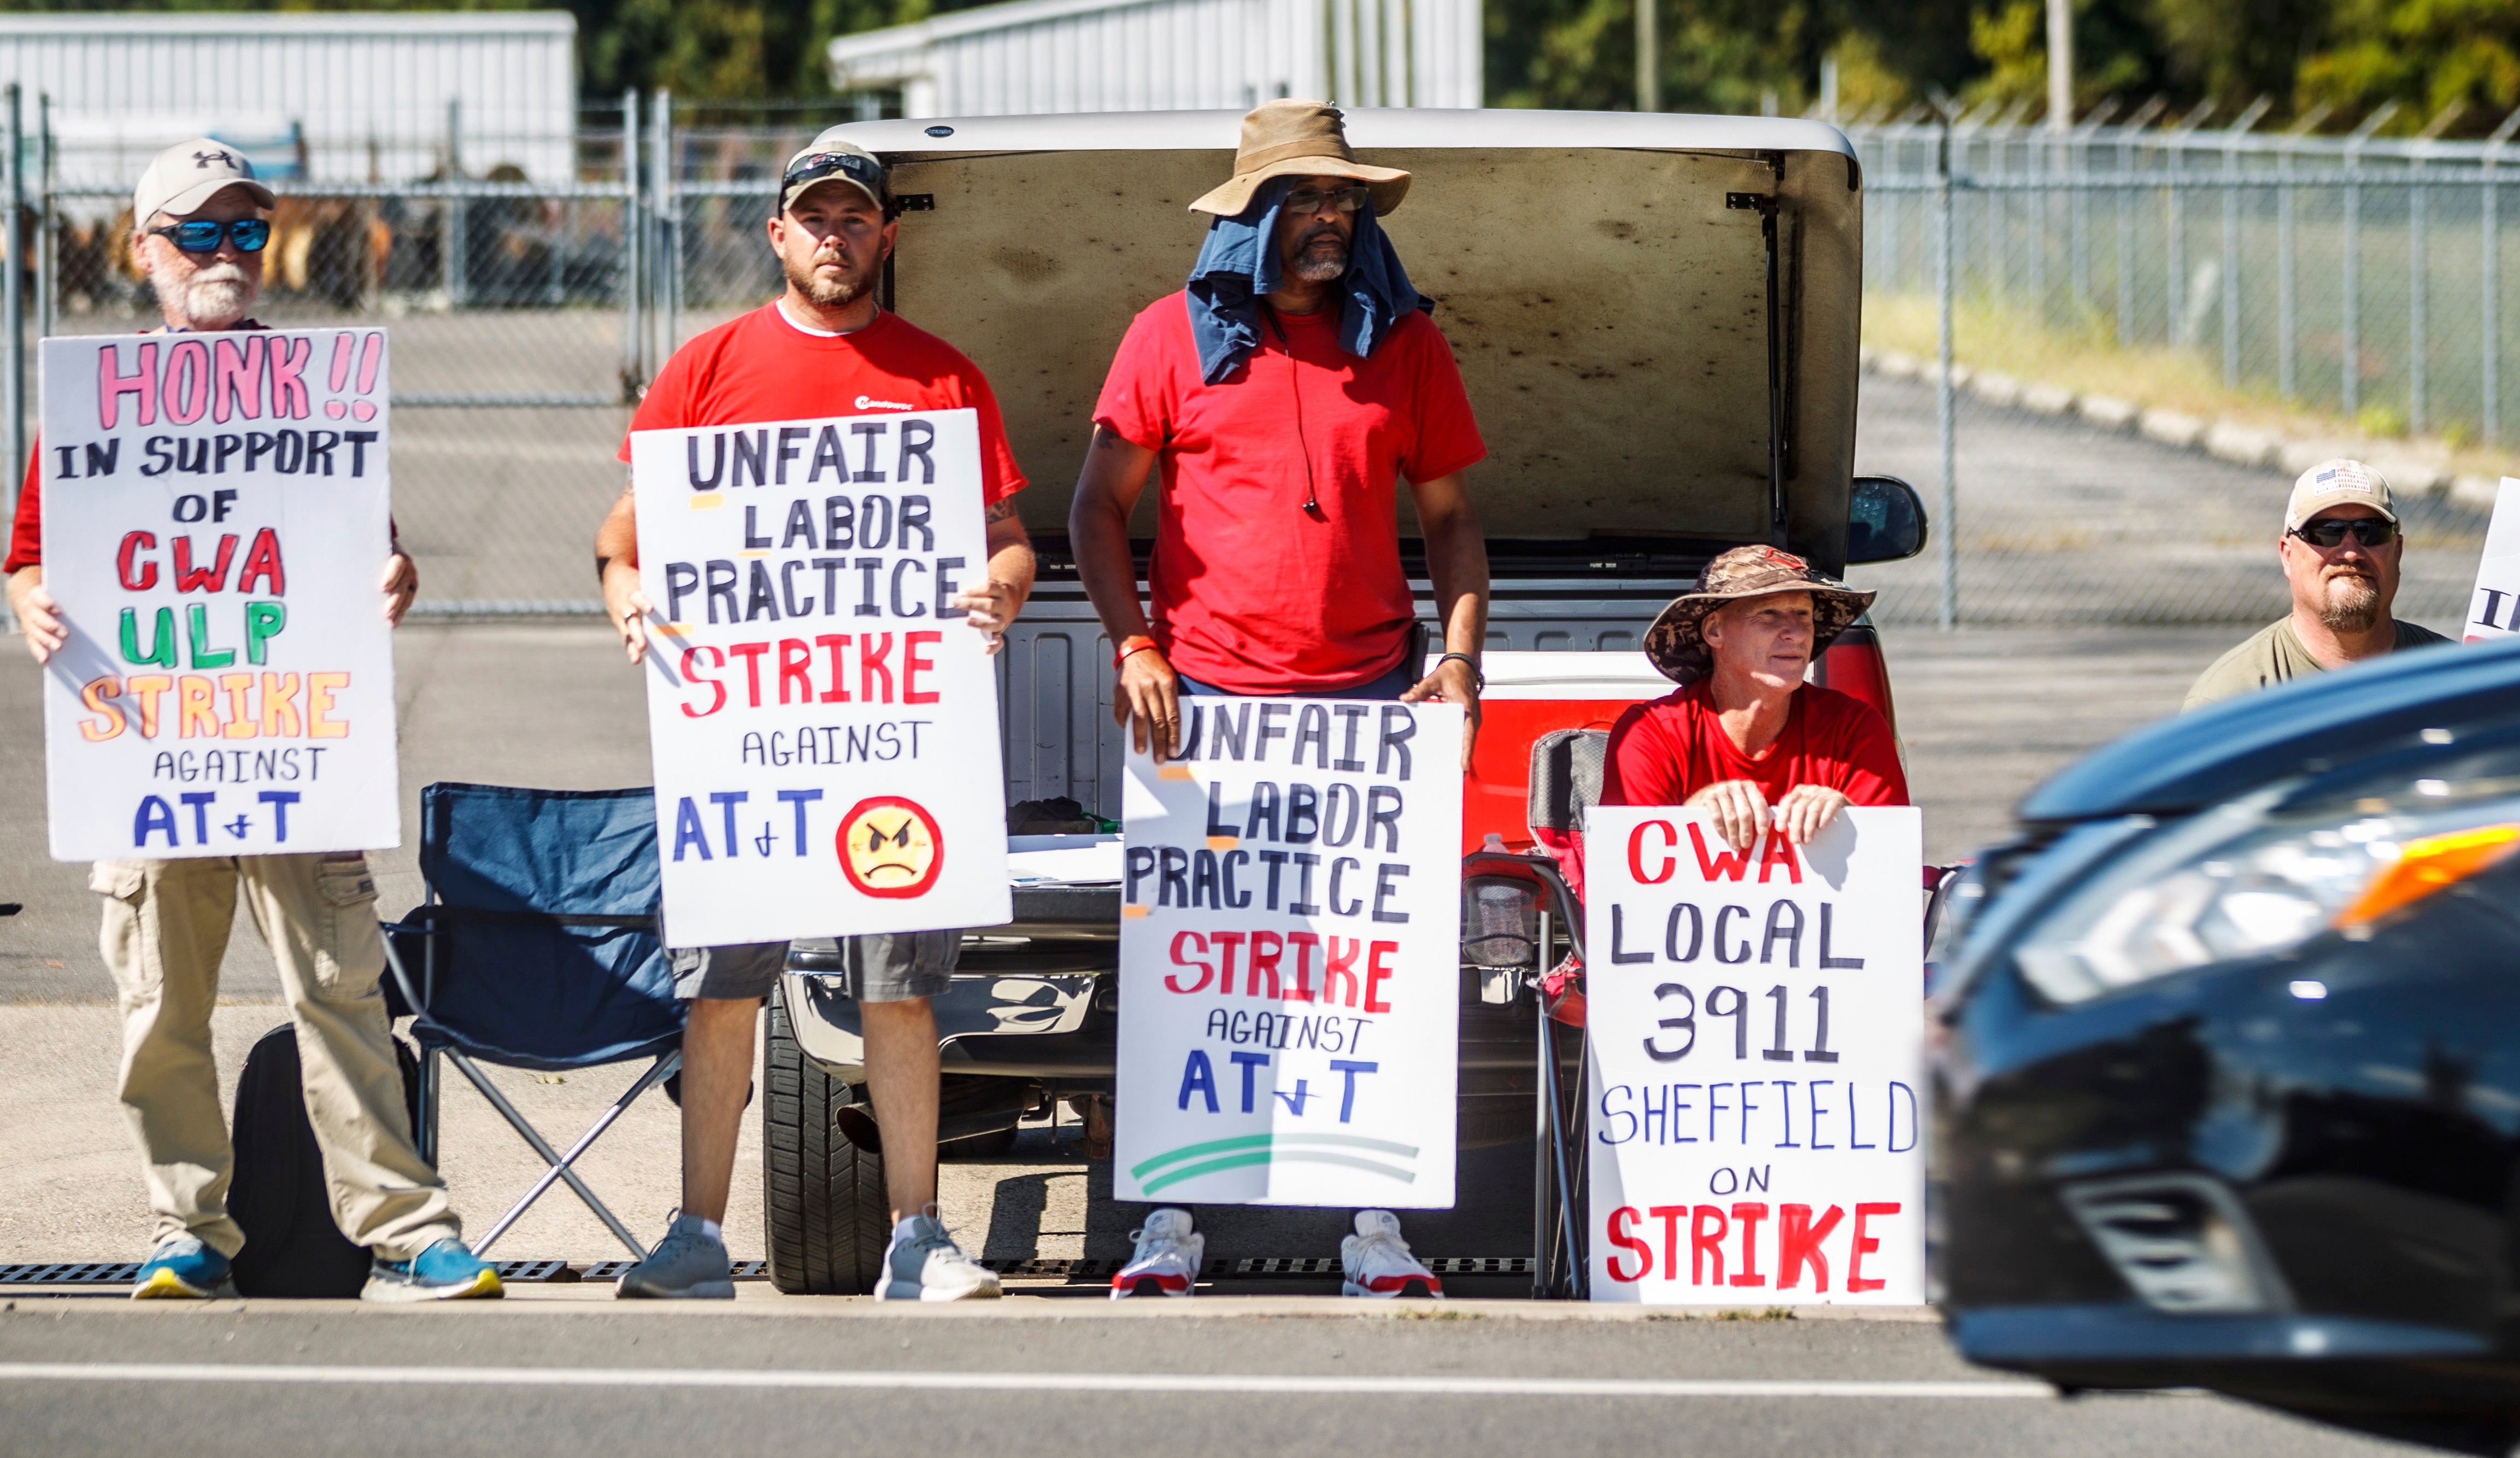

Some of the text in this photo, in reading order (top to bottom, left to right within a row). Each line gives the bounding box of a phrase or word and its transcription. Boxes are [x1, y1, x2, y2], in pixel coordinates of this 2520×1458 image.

[55, 429, 378, 479] IN SUPPORT
[688, 420, 936, 491] UNFAIR
[172, 489, 238, 523] OF
[745, 495, 933, 552] LABOR
[116, 528, 285, 596] CWA
[666, 557, 970, 624] PRACTICE
[119, 601, 286, 670] ULP
[2472, 588, 2520, 633] I
[78, 671, 351, 742] STRIKE
[680, 631, 943, 718] STRIKE
[154, 747, 326, 782] AGAINST
[743, 721, 932, 765] AGAINST
[1207, 781, 1403, 853] LABOR
[1125, 847, 1410, 923] PRACTICE
[1627, 819, 1803, 885] CWA
[1611, 899, 1865, 970] LOCAL
[1164, 930, 1400, 1013] STRIKE
[1207, 1009, 1373, 1054] AGAINST
[1643, 982, 1840, 1064] 3911
[1599, 1081, 1918, 1152] SHEFFIELD
[1710, 1164, 1770, 1194] ON
[1607, 1203, 1902, 1293] STRIKE
